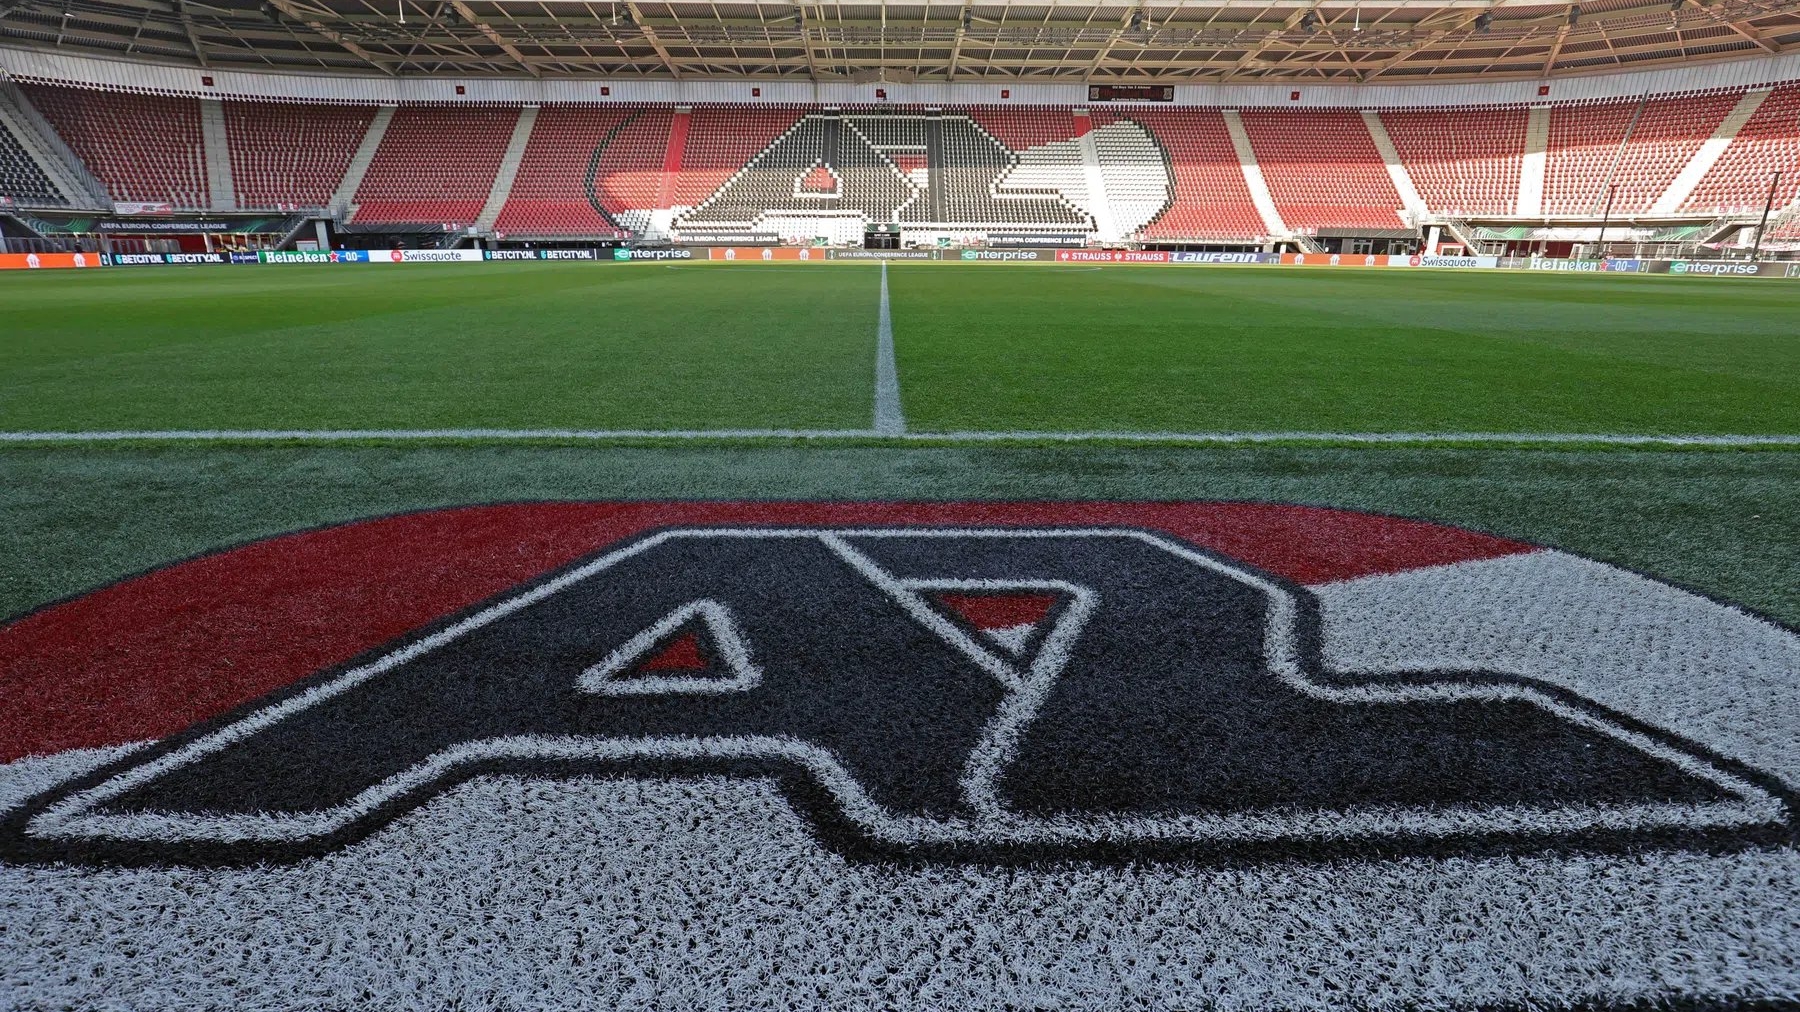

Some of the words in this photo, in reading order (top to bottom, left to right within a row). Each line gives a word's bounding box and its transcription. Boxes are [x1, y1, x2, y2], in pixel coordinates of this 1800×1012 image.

[123, 222, 151, 230] EUROPA
[265, 251, 330, 263] Heineken
[403, 250, 462, 262] Swissquote
[491, 250, 537, 260] BETCITY.NL
[546, 250, 592, 260] BETCITY.NL
[615, 248, 691, 261] enterprise
[962, 249, 1038, 262] enterprise
[1071, 252, 1112, 261] STRAUSS
[1124, 253, 1164, 262] STRAUSS
[1421, 256, 1477, 268] Swissquote
[1529, 257, 1597, 272] Heineken
[1671, 261, 1758, 276] enterprise
[15, 526, 1792, 856] AZ
